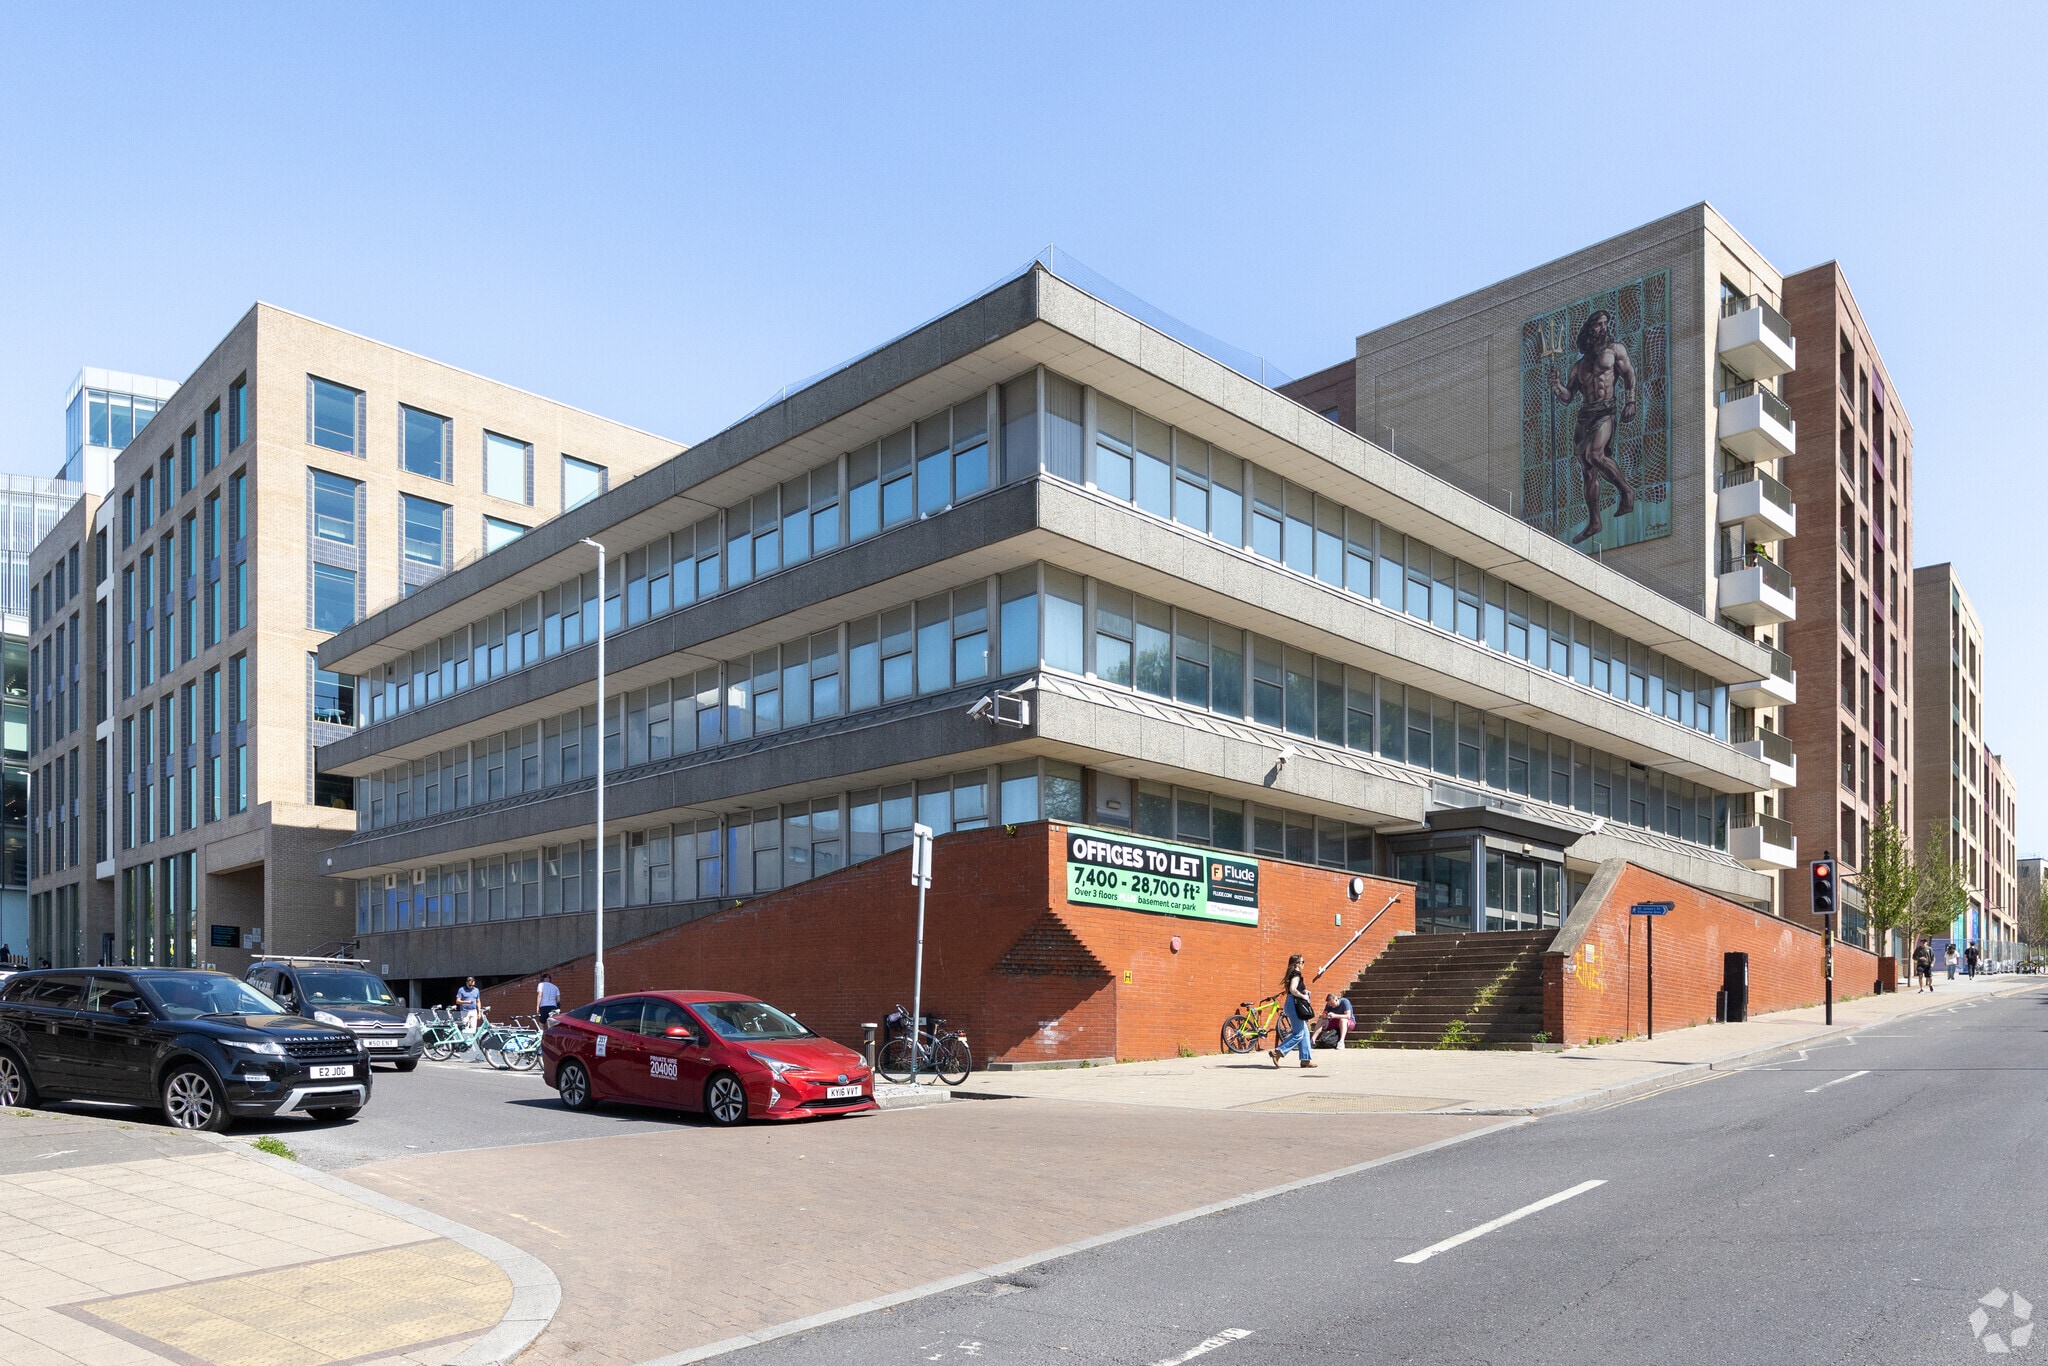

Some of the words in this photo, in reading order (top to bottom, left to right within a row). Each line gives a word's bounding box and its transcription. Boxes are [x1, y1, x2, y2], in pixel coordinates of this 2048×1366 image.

[1072, 838, 1144, 868] OFFICES
[1146, 850, 1167, 872] TO
[1170, 855, 1199, 877] LET
[1224, 865, 1255, 881] Flude
[1074, 866, 1118, 889] 7,400
[1131, 875, 1180, 898] 28,700
[1074, 887, 1091, 897] Over
[1093, 890, 1097, 898] 3
[1098, 889, 1118, 900] floors
[1119, 892, 1137, 903] PLUS
[1138, 896, 1170, 908] basement
[1171, 900, 1181, 909] car
[1182, 902, 1196, 911] park
[319, 1067, 330, 1077] E2
[650, 1061, 678, 1077] 204060
[831, 1088, 845, 1097] KY16
[847, 1087, 858, 1096] VVT
